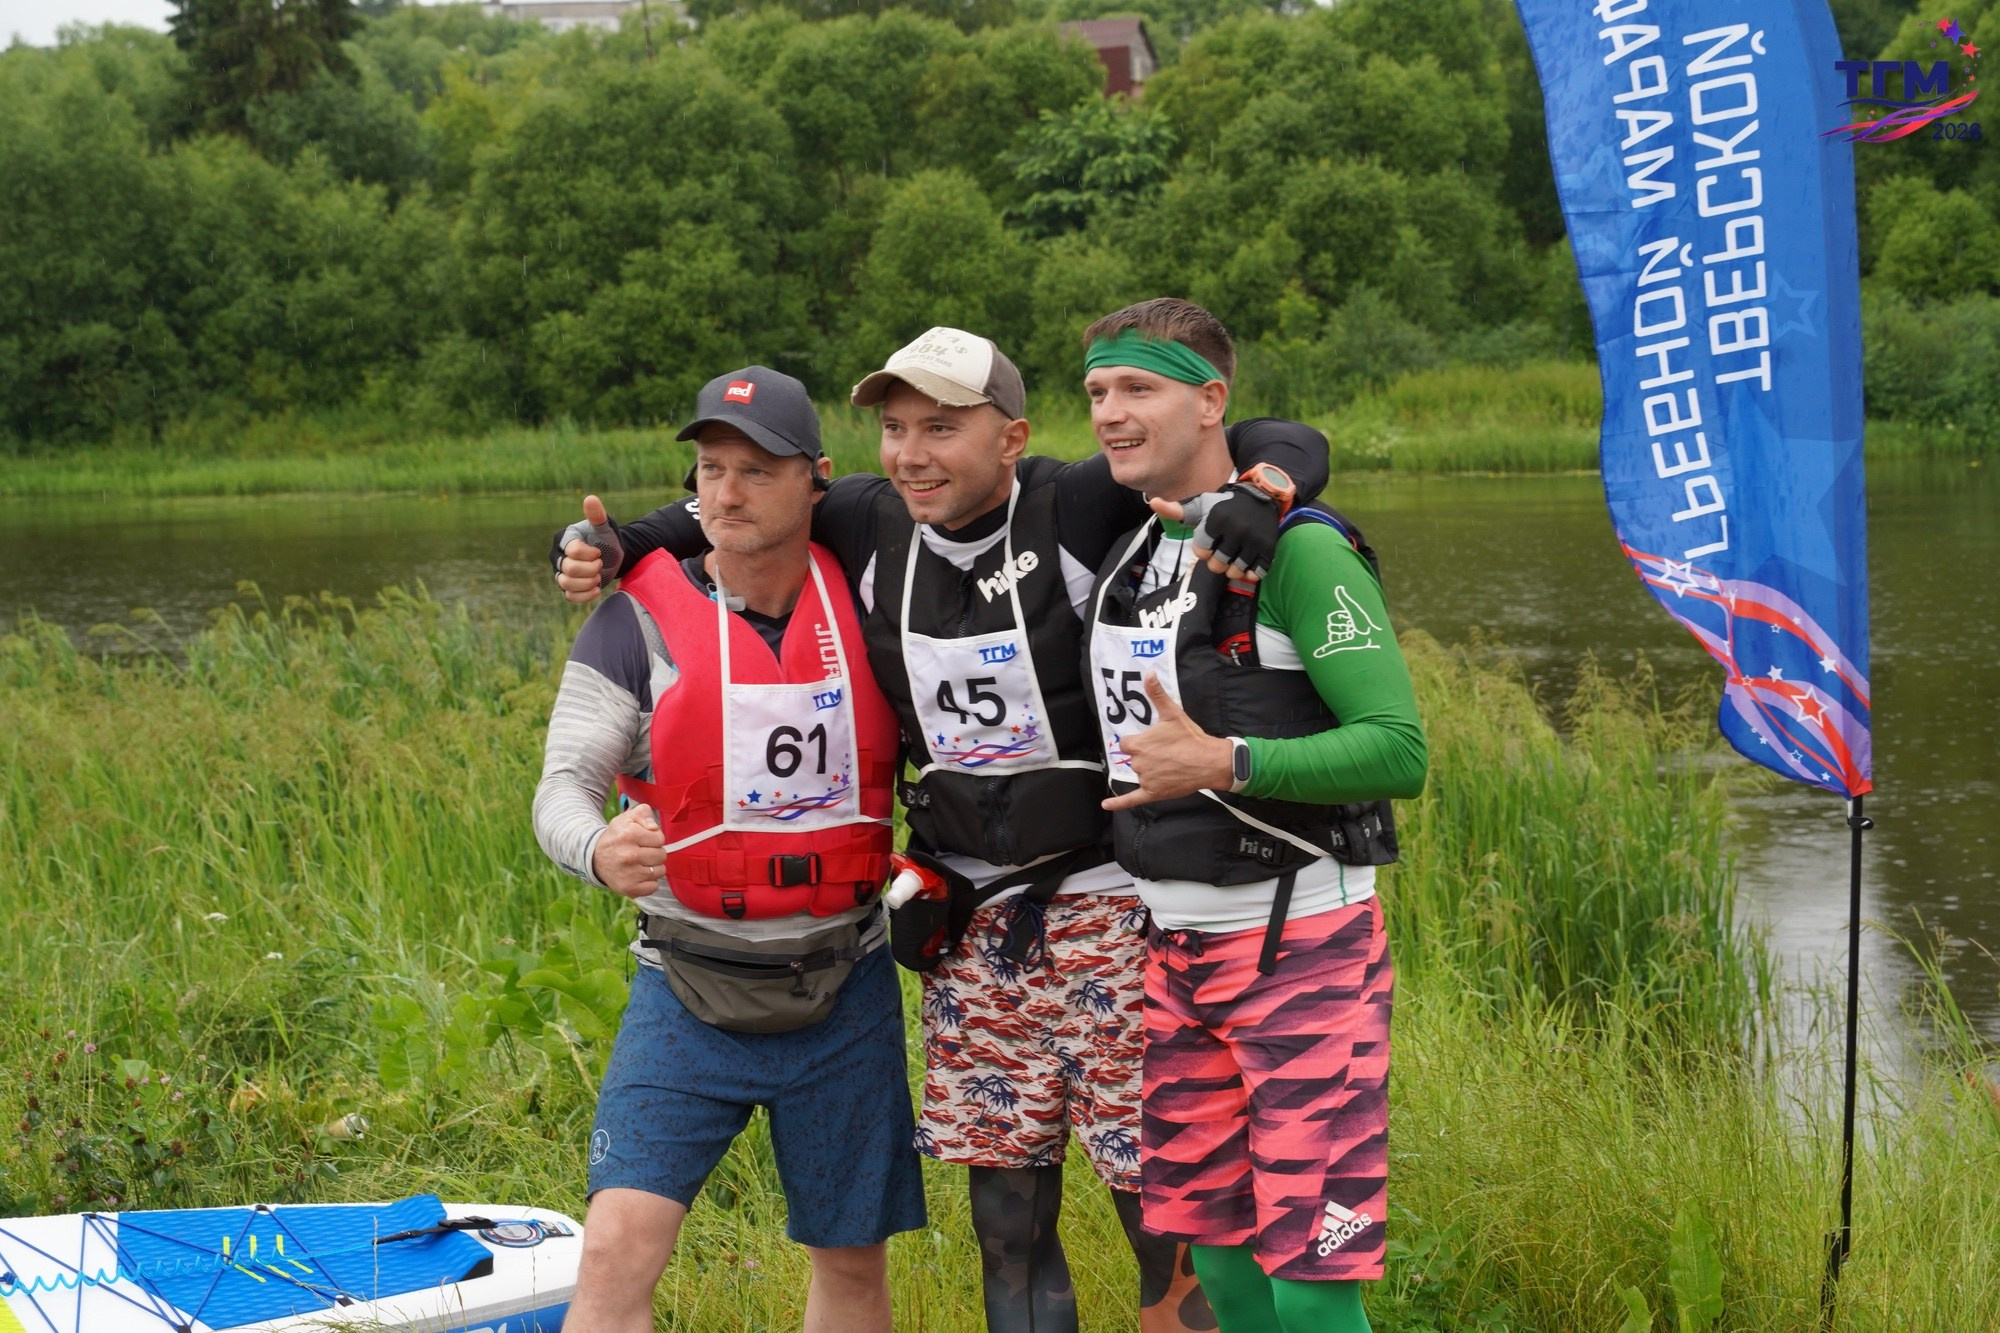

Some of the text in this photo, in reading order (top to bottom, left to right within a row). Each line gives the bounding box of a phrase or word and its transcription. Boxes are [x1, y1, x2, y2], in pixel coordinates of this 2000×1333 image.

[728, 383, 753, 397] red
[936, 677, 1007, 727] 45
[766, 723, 827, 778] 61
[1317, 1213, 1373, 1257] adidas
